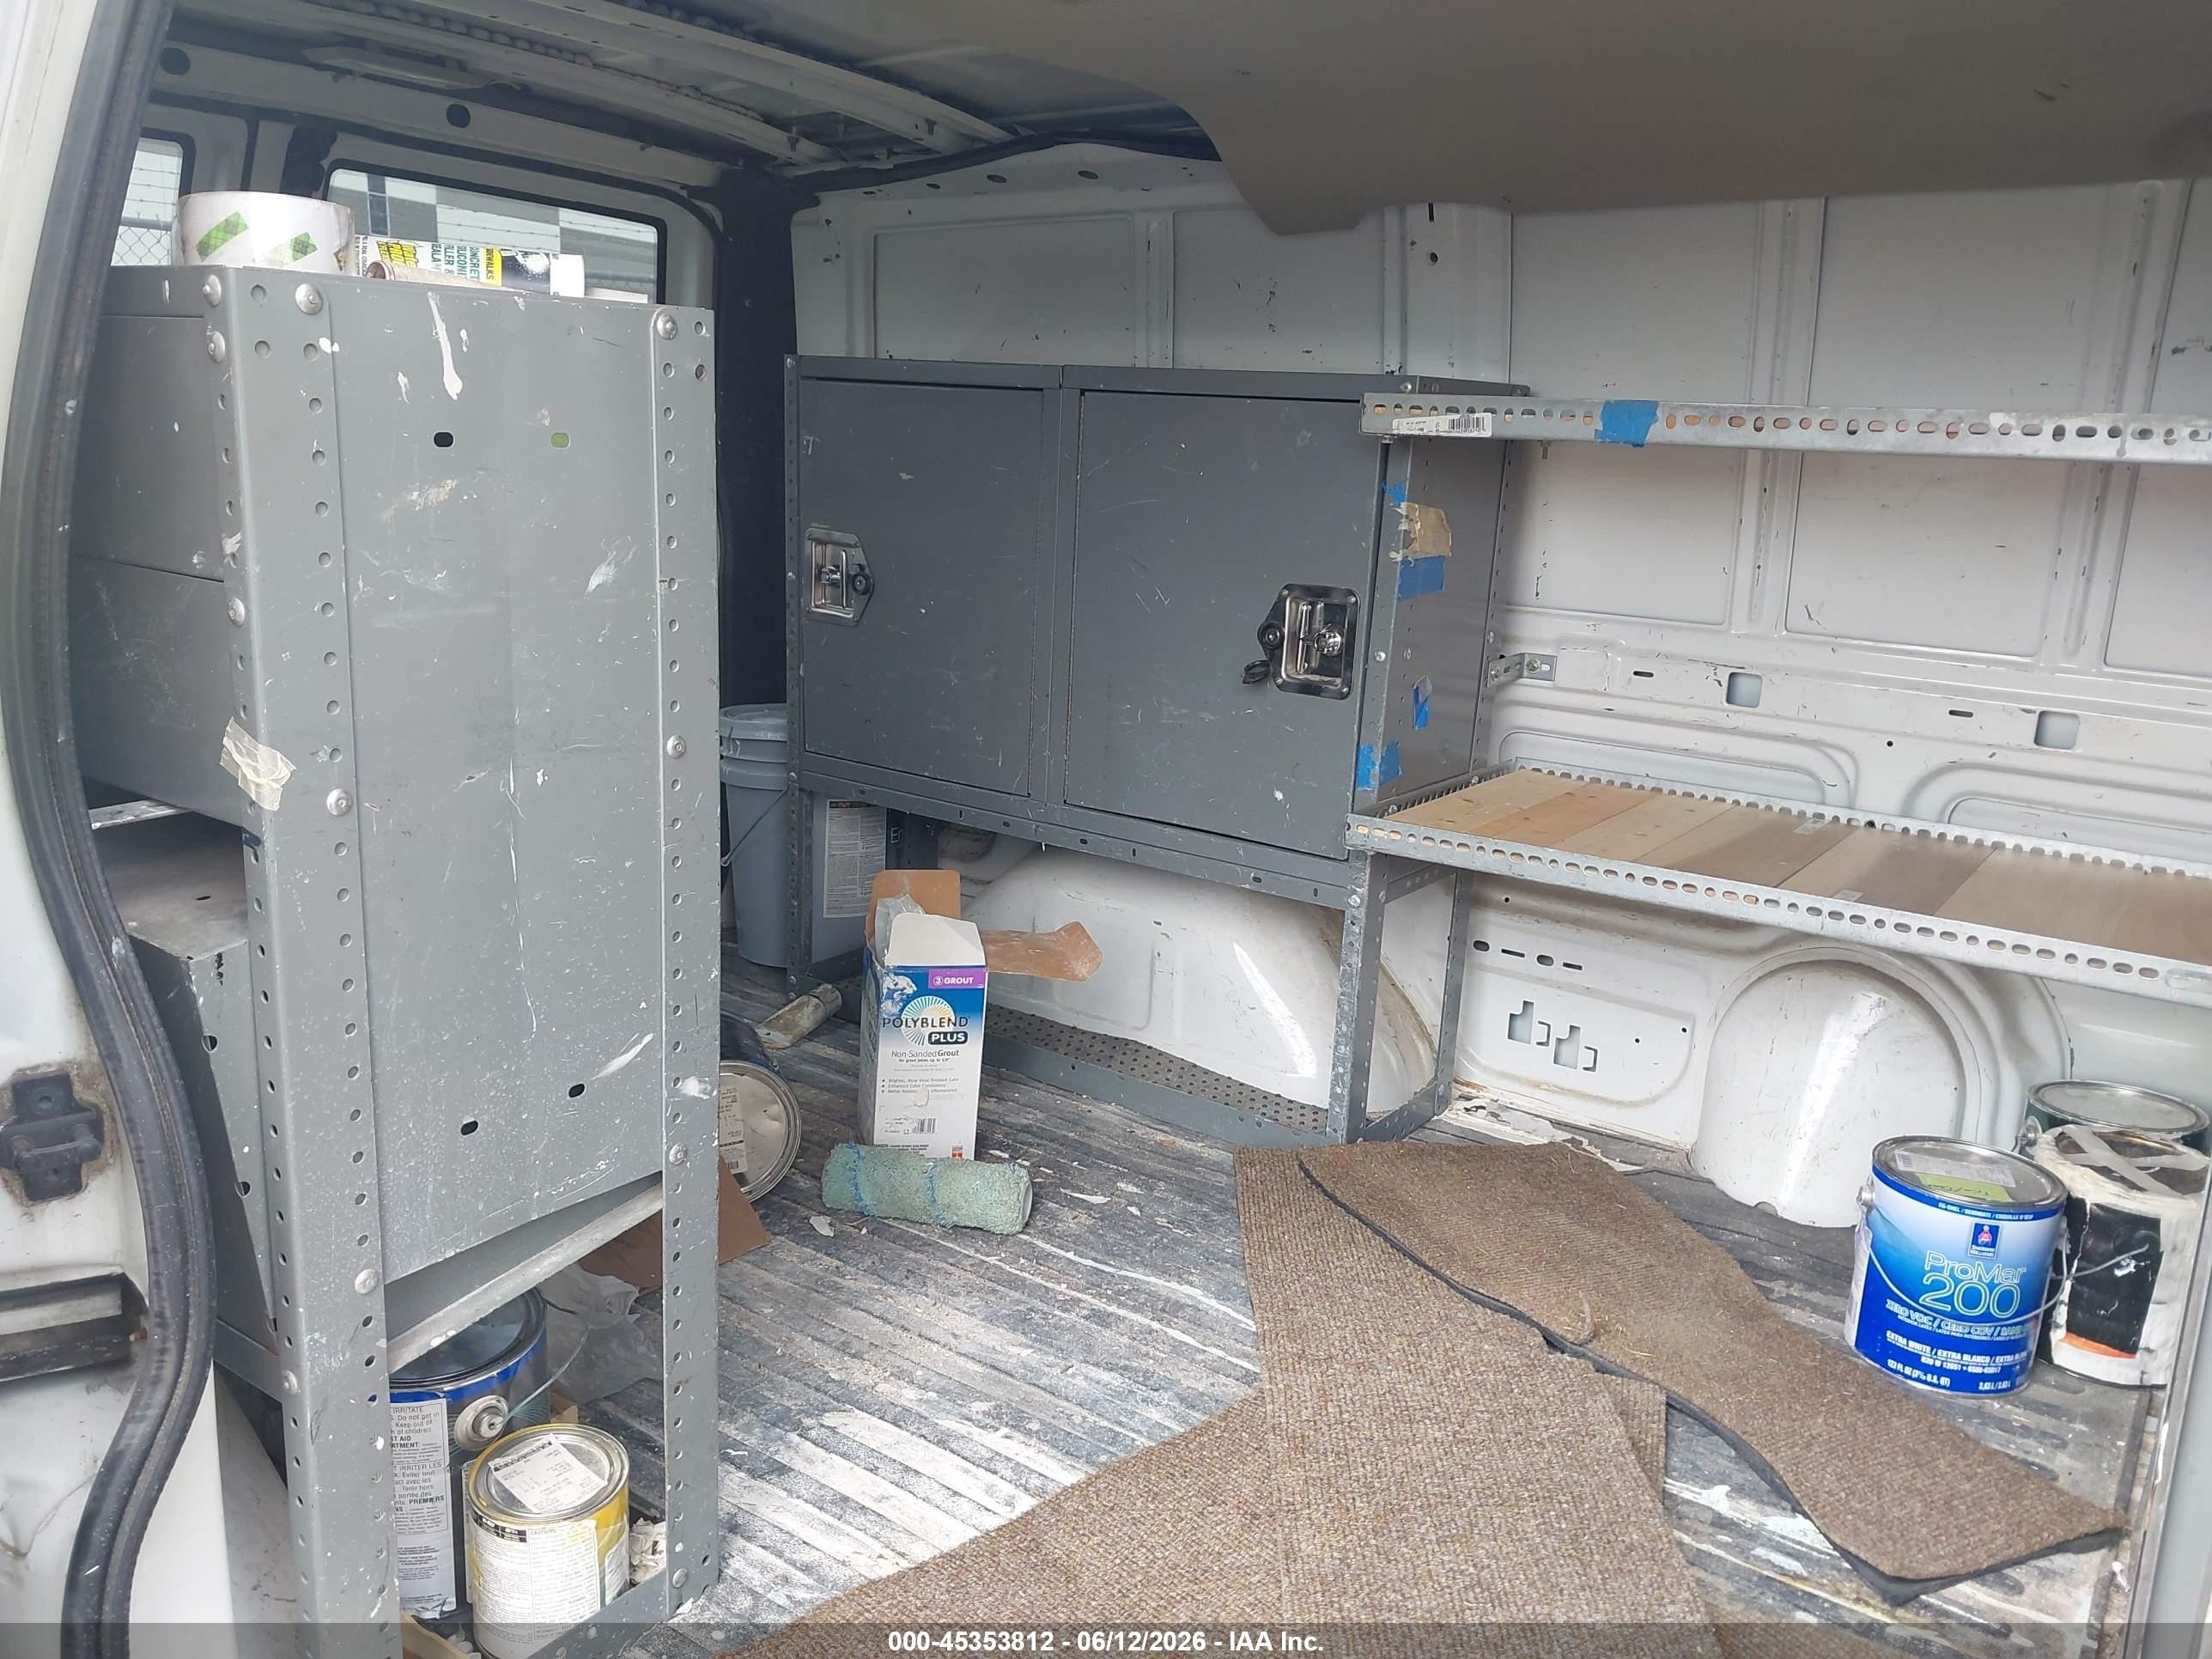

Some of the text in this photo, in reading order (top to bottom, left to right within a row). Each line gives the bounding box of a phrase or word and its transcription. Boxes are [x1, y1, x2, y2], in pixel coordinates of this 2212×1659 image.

[470, 246, 480, 282] CONCRET
[944, 976, 975, 985] GROUT
[882, 1016, 969, 1029] POLYBLEND
[931, 1032, 965, 1042] PLUS
[891, 1049, 937, 1058] Non-Sanded
[1924, 1249, 2027, 1284] ProMar
[1919, 1273, 2021, 1318] 200
[1886, 1298, 1910, 1317] ZERO
[1909, 1309, 1933, 1326] VOC
[1886, 1330, 1907, 1346] EXTRA
[1908, 1339, 1931, 1354] WHITE
[1936, 1349, 1961, 1360] EXTRA
[1995, 1354, 2014, 1363] EXTRA
[409, 1495, 445, 1505] PREMIERS
